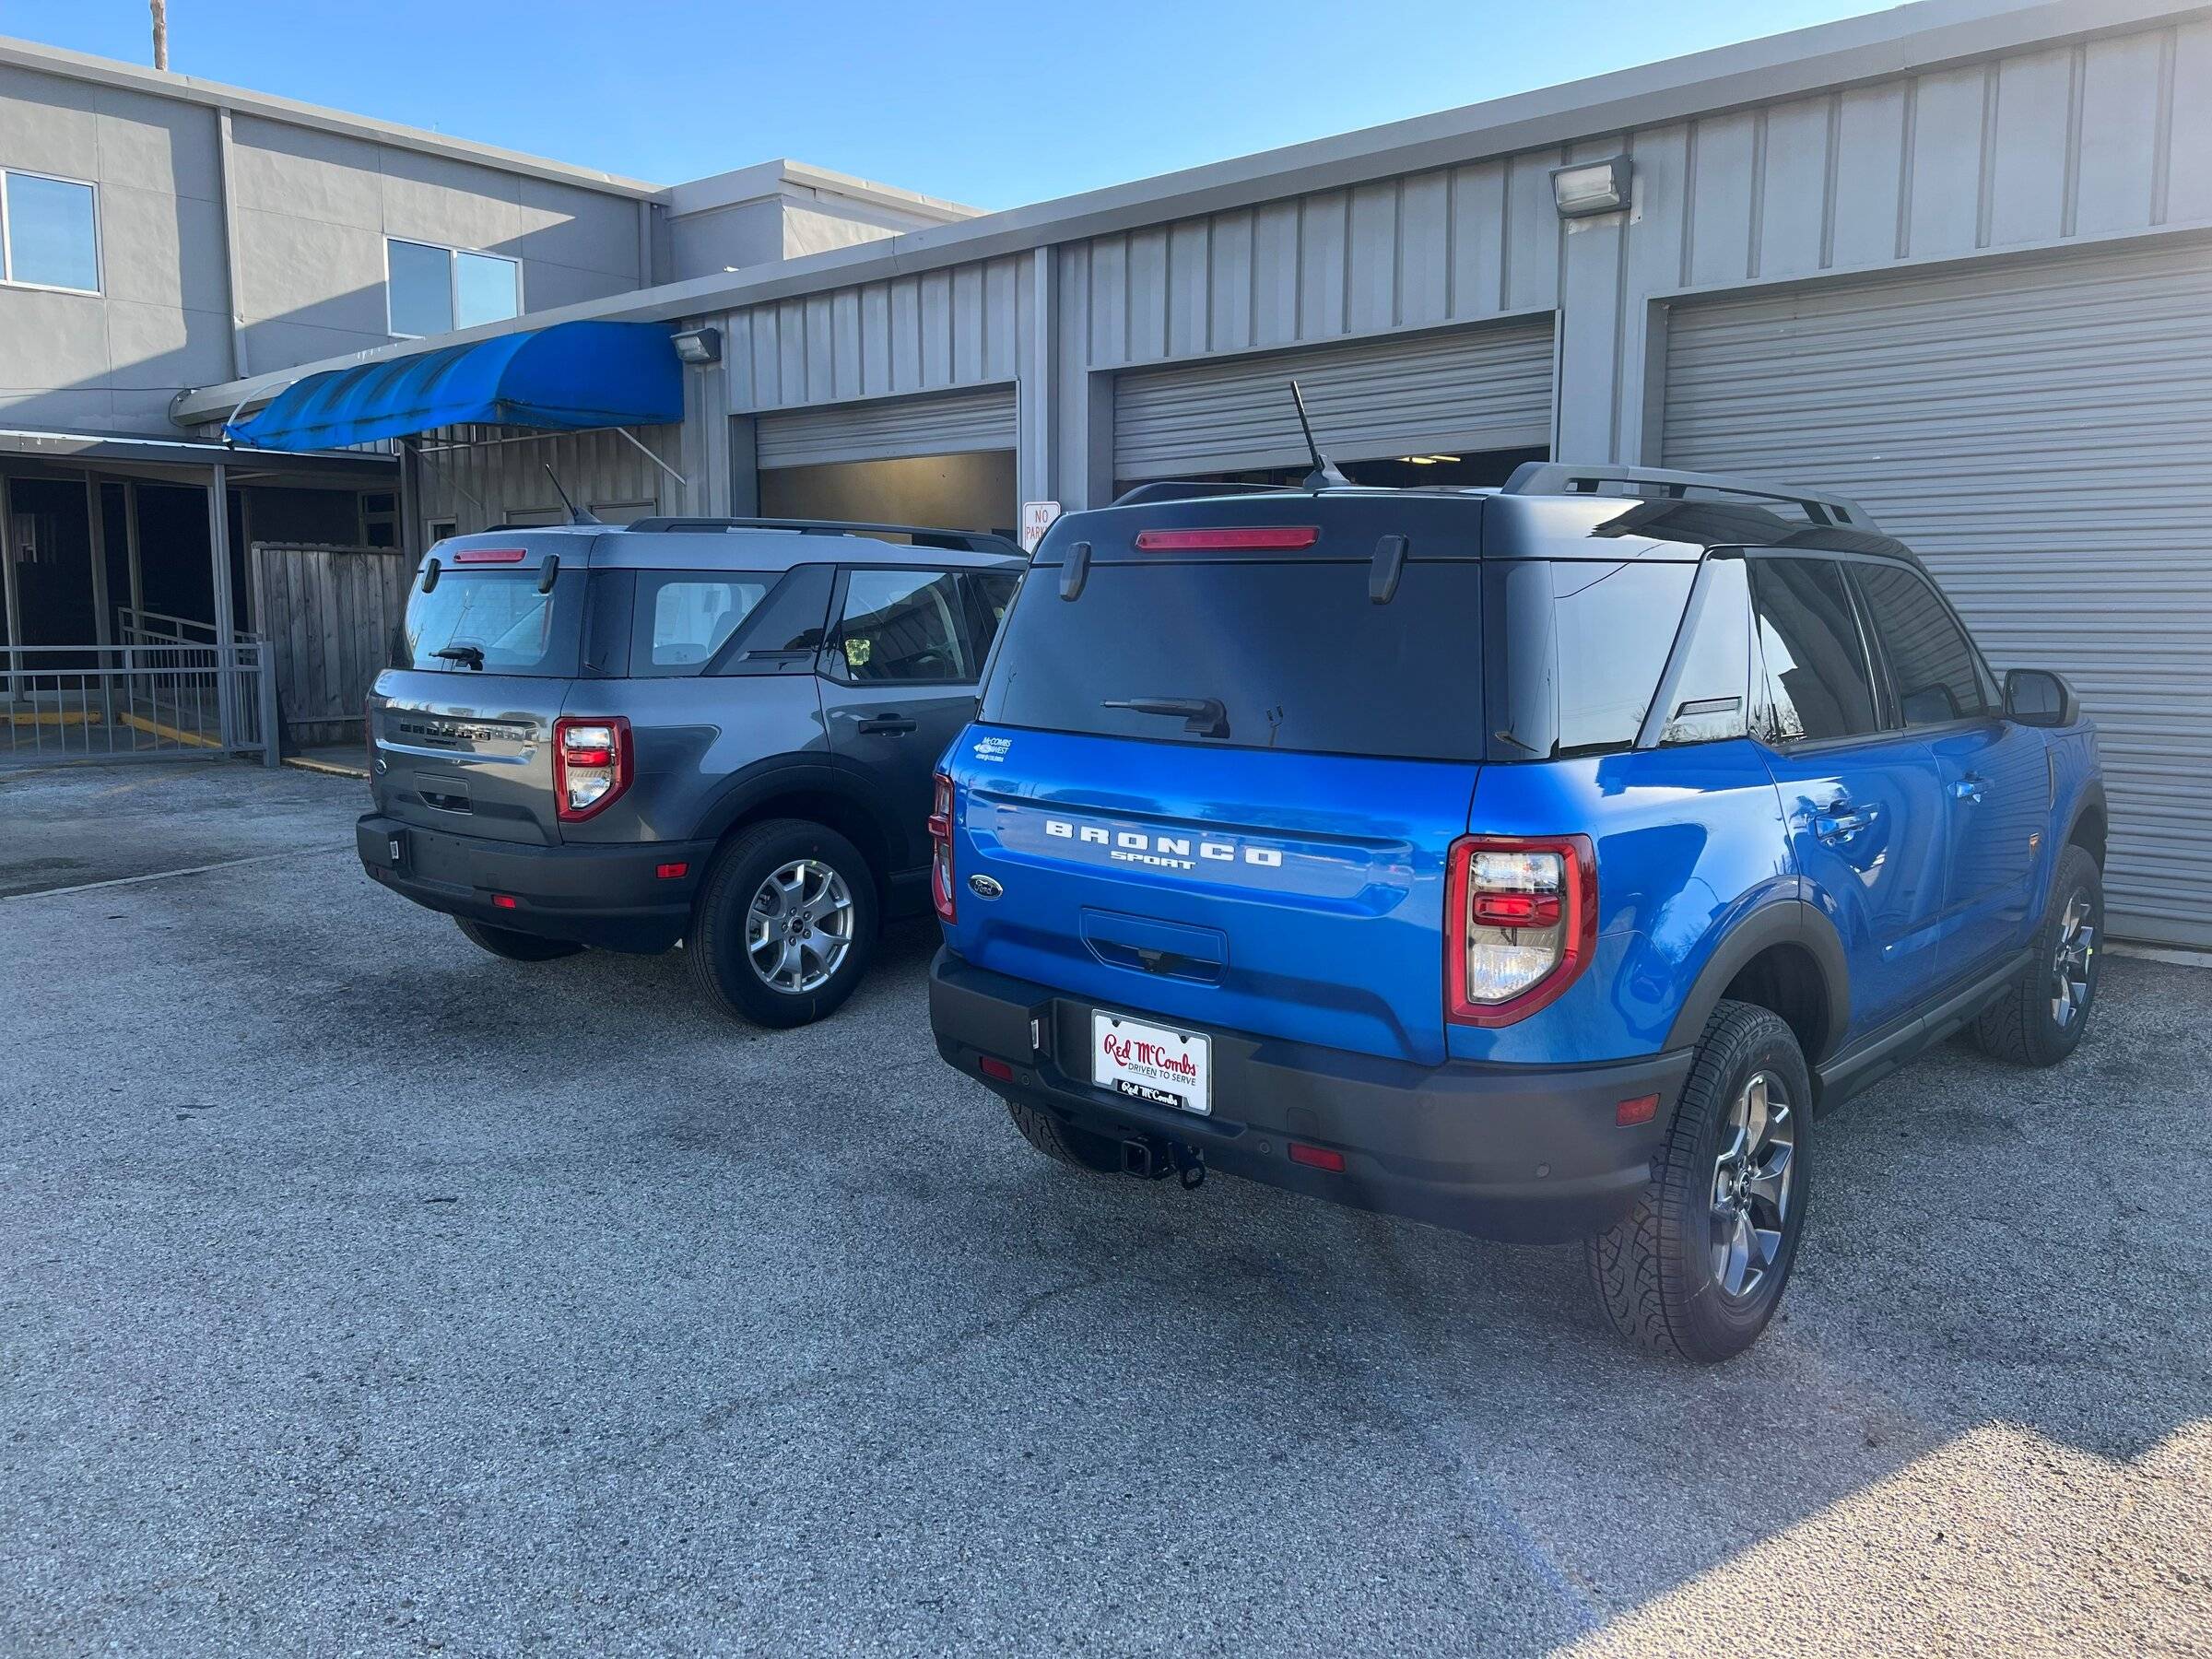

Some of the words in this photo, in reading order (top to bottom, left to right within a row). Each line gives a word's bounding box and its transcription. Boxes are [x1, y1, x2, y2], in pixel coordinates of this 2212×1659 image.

[1035, 510, 1048, 523] NO
[1045, 819, 1283, 867] BRONCO
[1110, 850, 1196, 870] SPORT
[1104, 1033, 1131, 1066] Red
[1134, 1041, 1196, 1077] McCombs
[1127, 1062, 1158, 1077] DRIVEN
[1159, 1069, 1171, 1080] TO
[1171, 1074, 1196, 1087] SERVE
[1121, 1081, 1139, 1096] Red
[1139, 1085, 1178, 1106] McCombs
